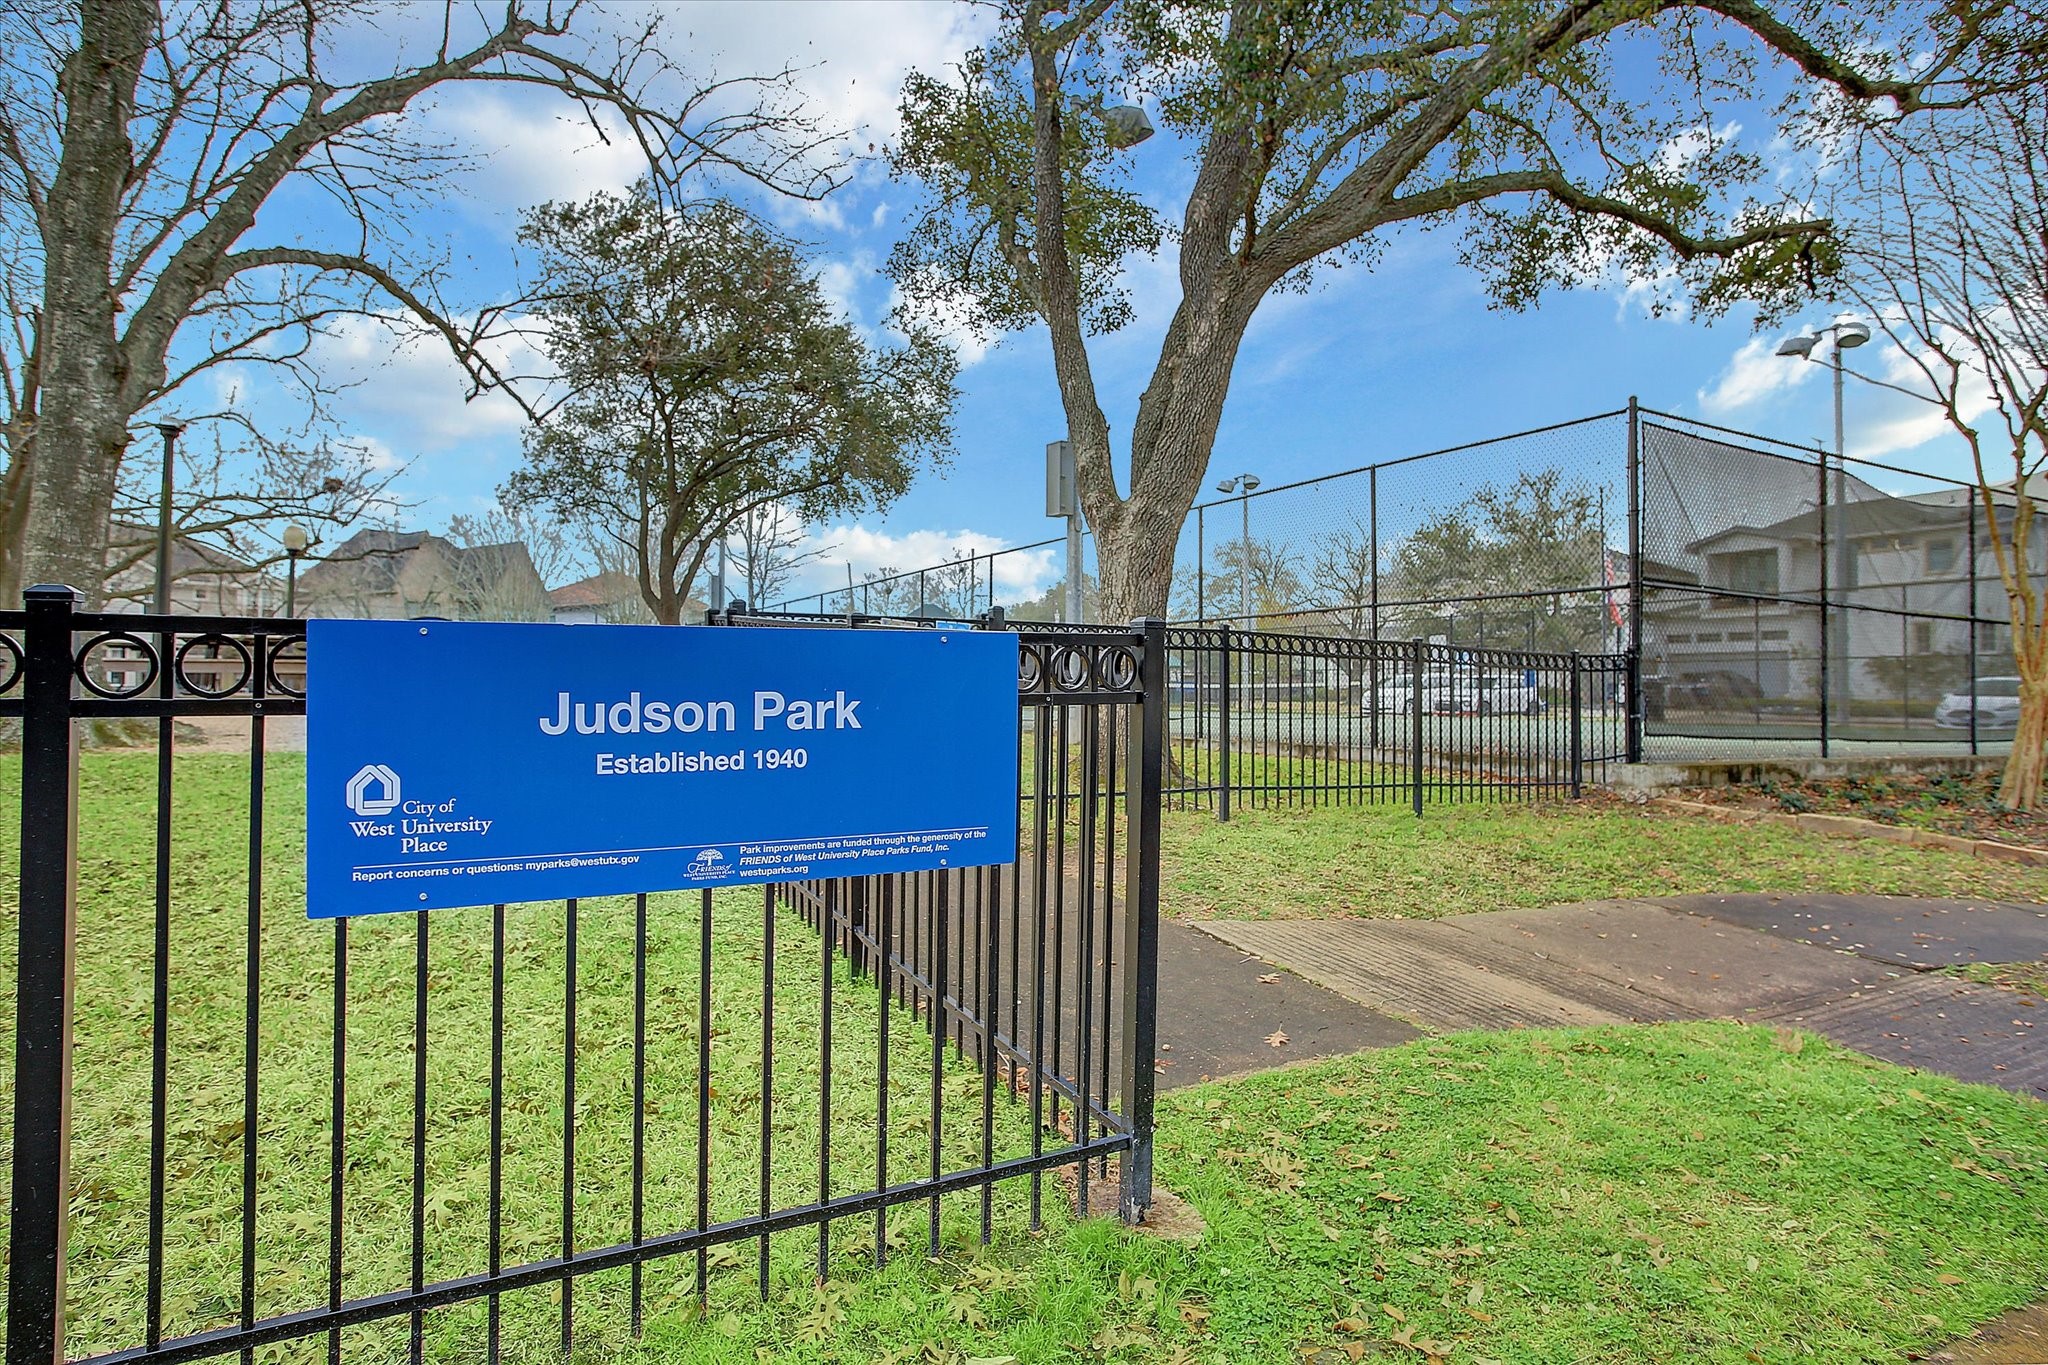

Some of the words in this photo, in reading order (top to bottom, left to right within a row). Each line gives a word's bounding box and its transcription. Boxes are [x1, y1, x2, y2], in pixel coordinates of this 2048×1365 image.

[540, 692, 734, 735] Judson
[755, 691, 861, 730] Park
[597, 750, 744, 774] Established
[753, 749, 807, 769] 1940
[403, 801, 436, 816] City
[439, 798, 456, 812] of
[349, 821, 395, 837] West
[401, 817, 492, 834] University
[401, 837, 447, 853] Place
[740, 846, 761, 855] Park
[763, 843, 825, 854] improvements
[842, 838, 872, 848] funded
[873, 836, 905, 848] through
[922, 832, 963, 843] generosity
[740, 855, 781, 865] FRIENDS
[783, 854, 793, 862] of
[795, 853, 816, 861] West
[818, 848, 860, 860] University
[886, 847, 909, 855] Parks
[911, 845, 933, 854] Fund,
[353, 871, 393, 882] Report
[396, 868, 449, 878] concerns
[466, 863, 523, 875] questions:
[525, 856, 639, 871] myparks@westutx.gov
[740, 866, 808, 877] westuparks.org
